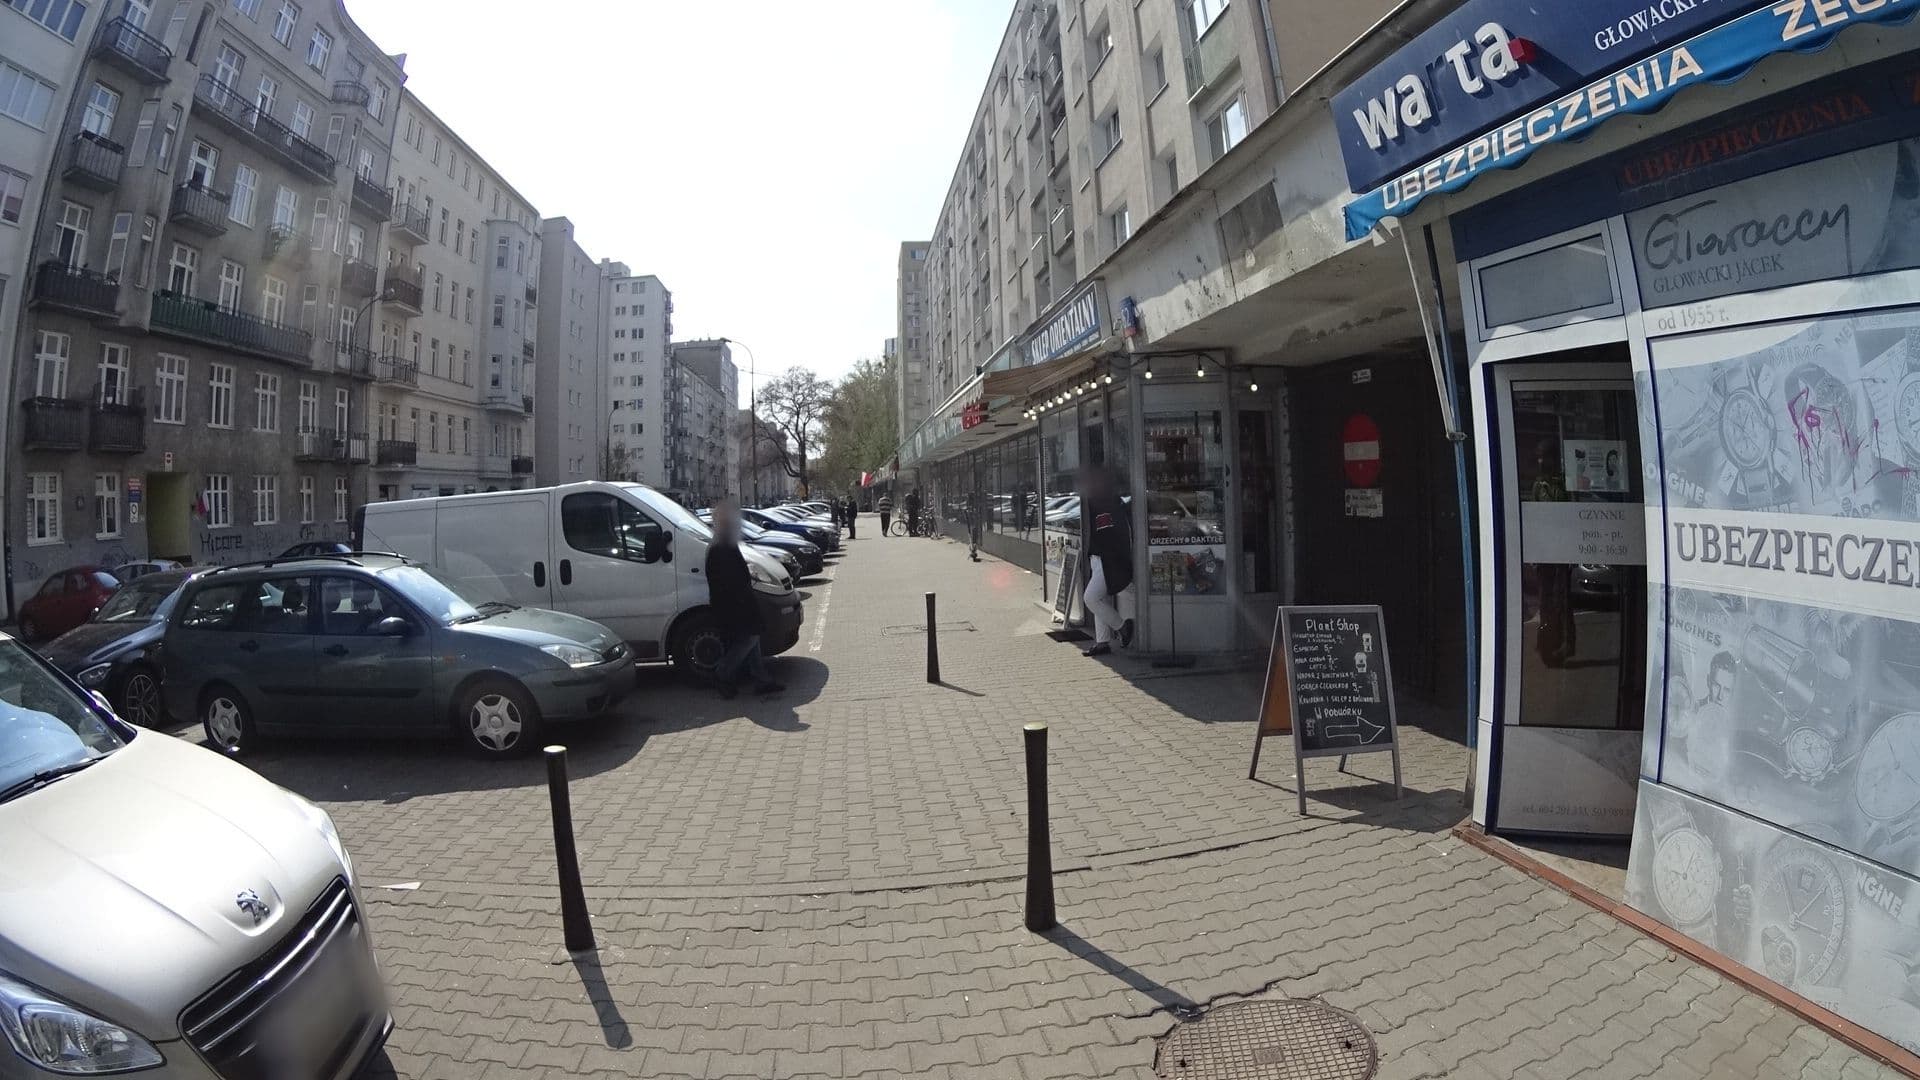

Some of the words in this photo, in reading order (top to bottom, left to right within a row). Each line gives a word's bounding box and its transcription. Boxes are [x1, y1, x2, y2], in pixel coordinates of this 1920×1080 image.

[1381, 46, 1704, 209] UBEZPIECZENIA
[1624, 93, 1873, 185] UBEZPIECZENIA
[1735, 253, 1785, 283] JACEK
[1031, 329, 1050, 365] SKLEP
[1049, 291, 1096, 353] ORIENTALNY
[1658, 313, 1676, 331] od
[1680, 304, 1716, 327] 1955
[1578, 509, 1625, 521] CZYNNE
[1150, 537, 1185, 545] ORZECHY
[1190, 535, 1224, 543] DAKTYLE
[1611, 528, 1624, 541] pt.
[1673, 521, 1920, 588] UBEZPIECZE
[1305, 617, 1335, 632] Plant
[1336, 617, 1360, 636] Shop
